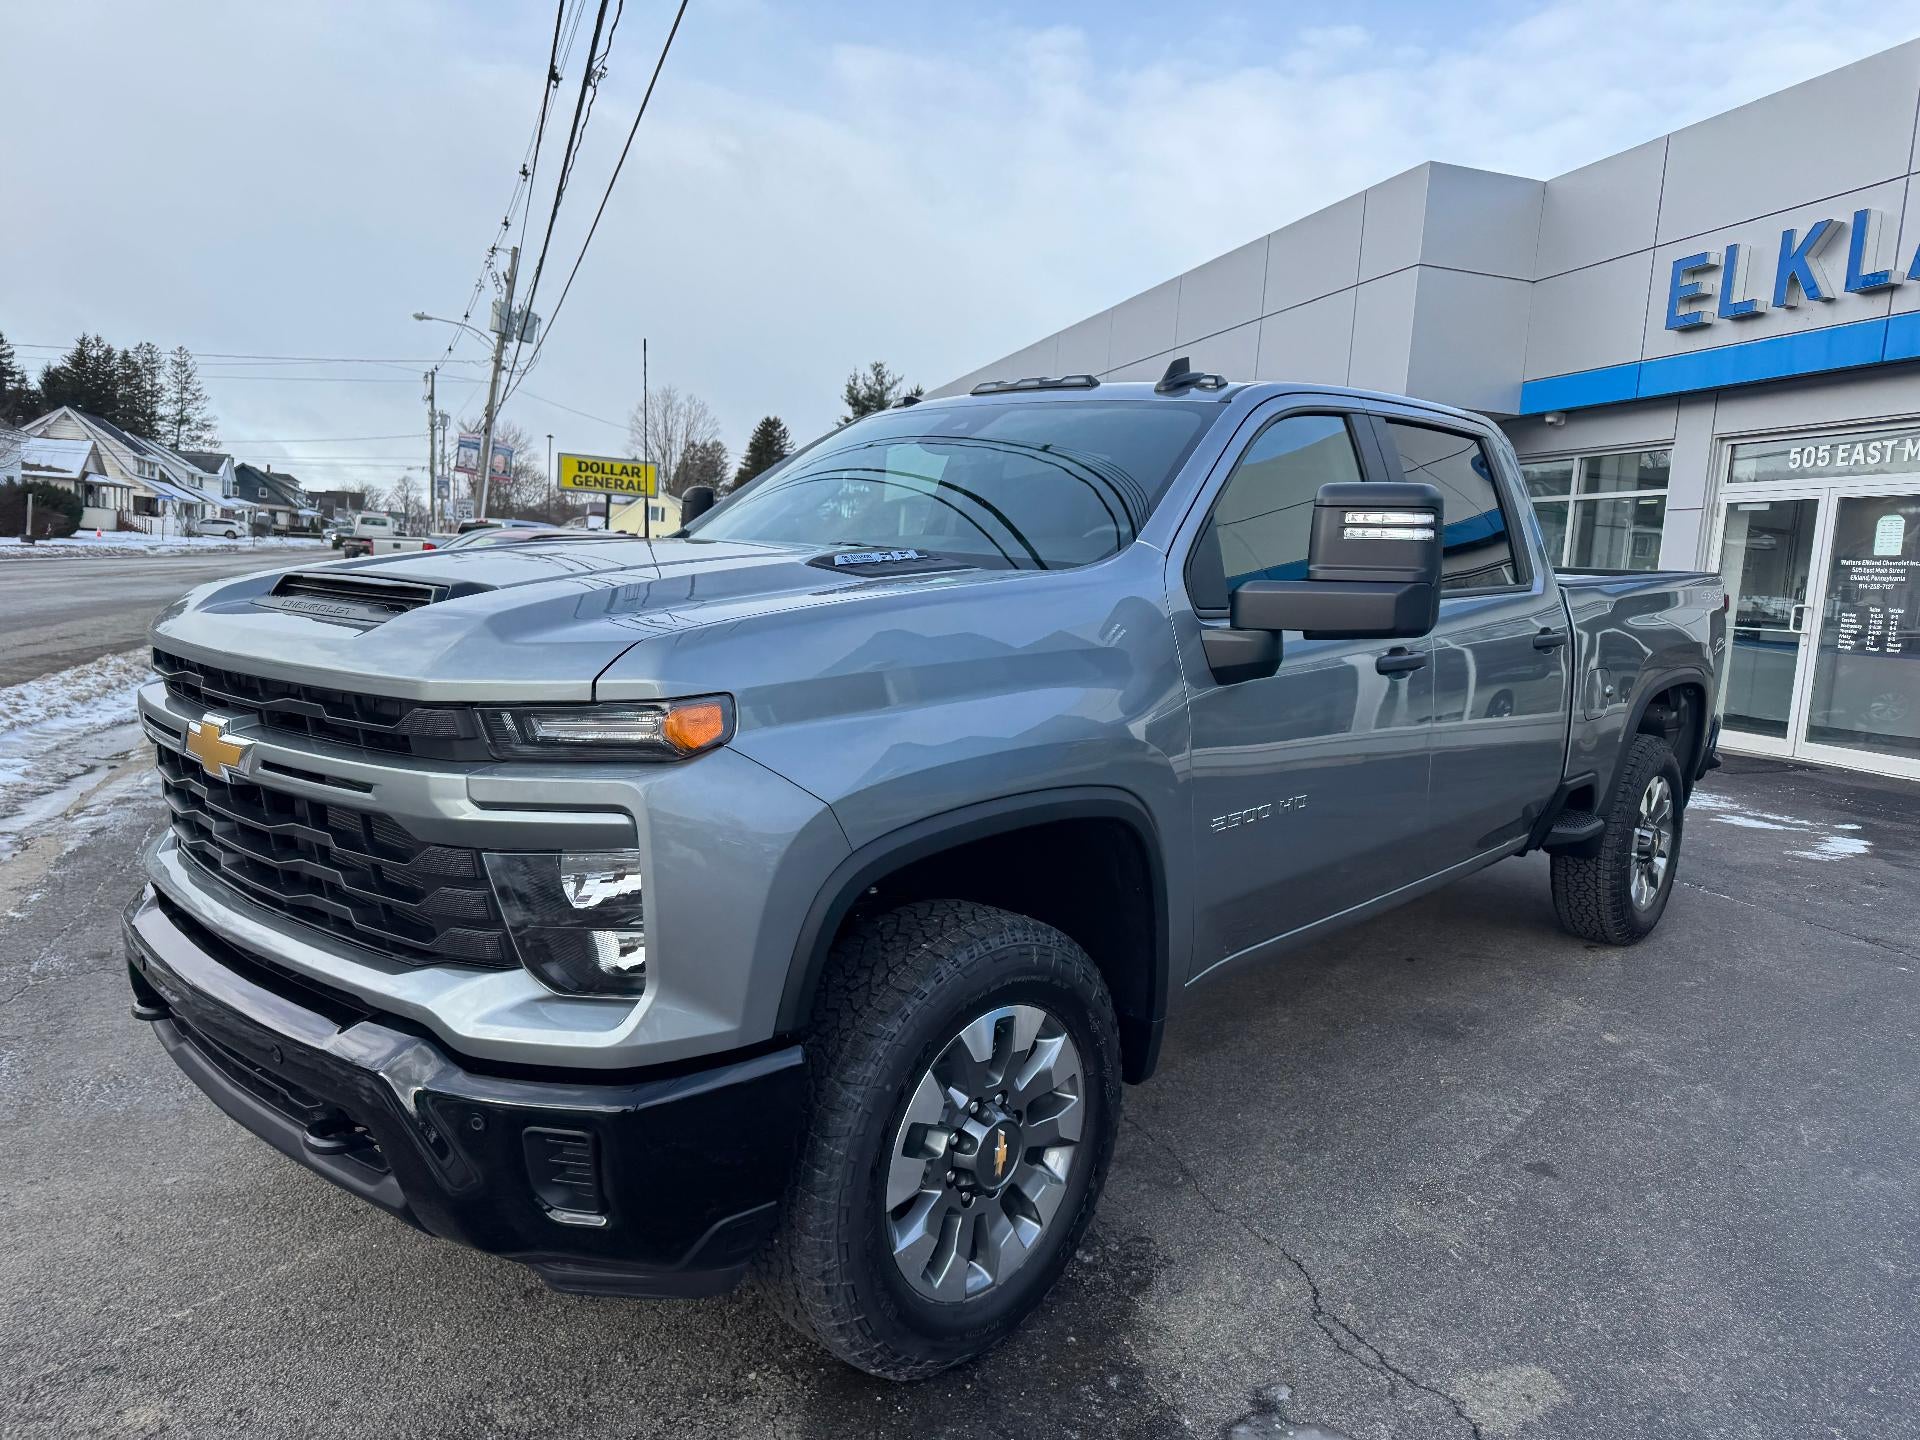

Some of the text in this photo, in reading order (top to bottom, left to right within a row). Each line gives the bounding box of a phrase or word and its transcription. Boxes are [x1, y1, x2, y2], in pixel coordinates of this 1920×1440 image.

[1665, 208, 1920, 331] ELKL
[1788, 445, 1831, 469] 505
[1836, 440, 1899, 466] EAST
[572, 460, 646, 492] DOLLAR GENERAL
[458, 510, 473, 519] 35
[281, 599, 357, 616] CHEVROLET
[1210, 794, 1308, 834] 2500 HD
